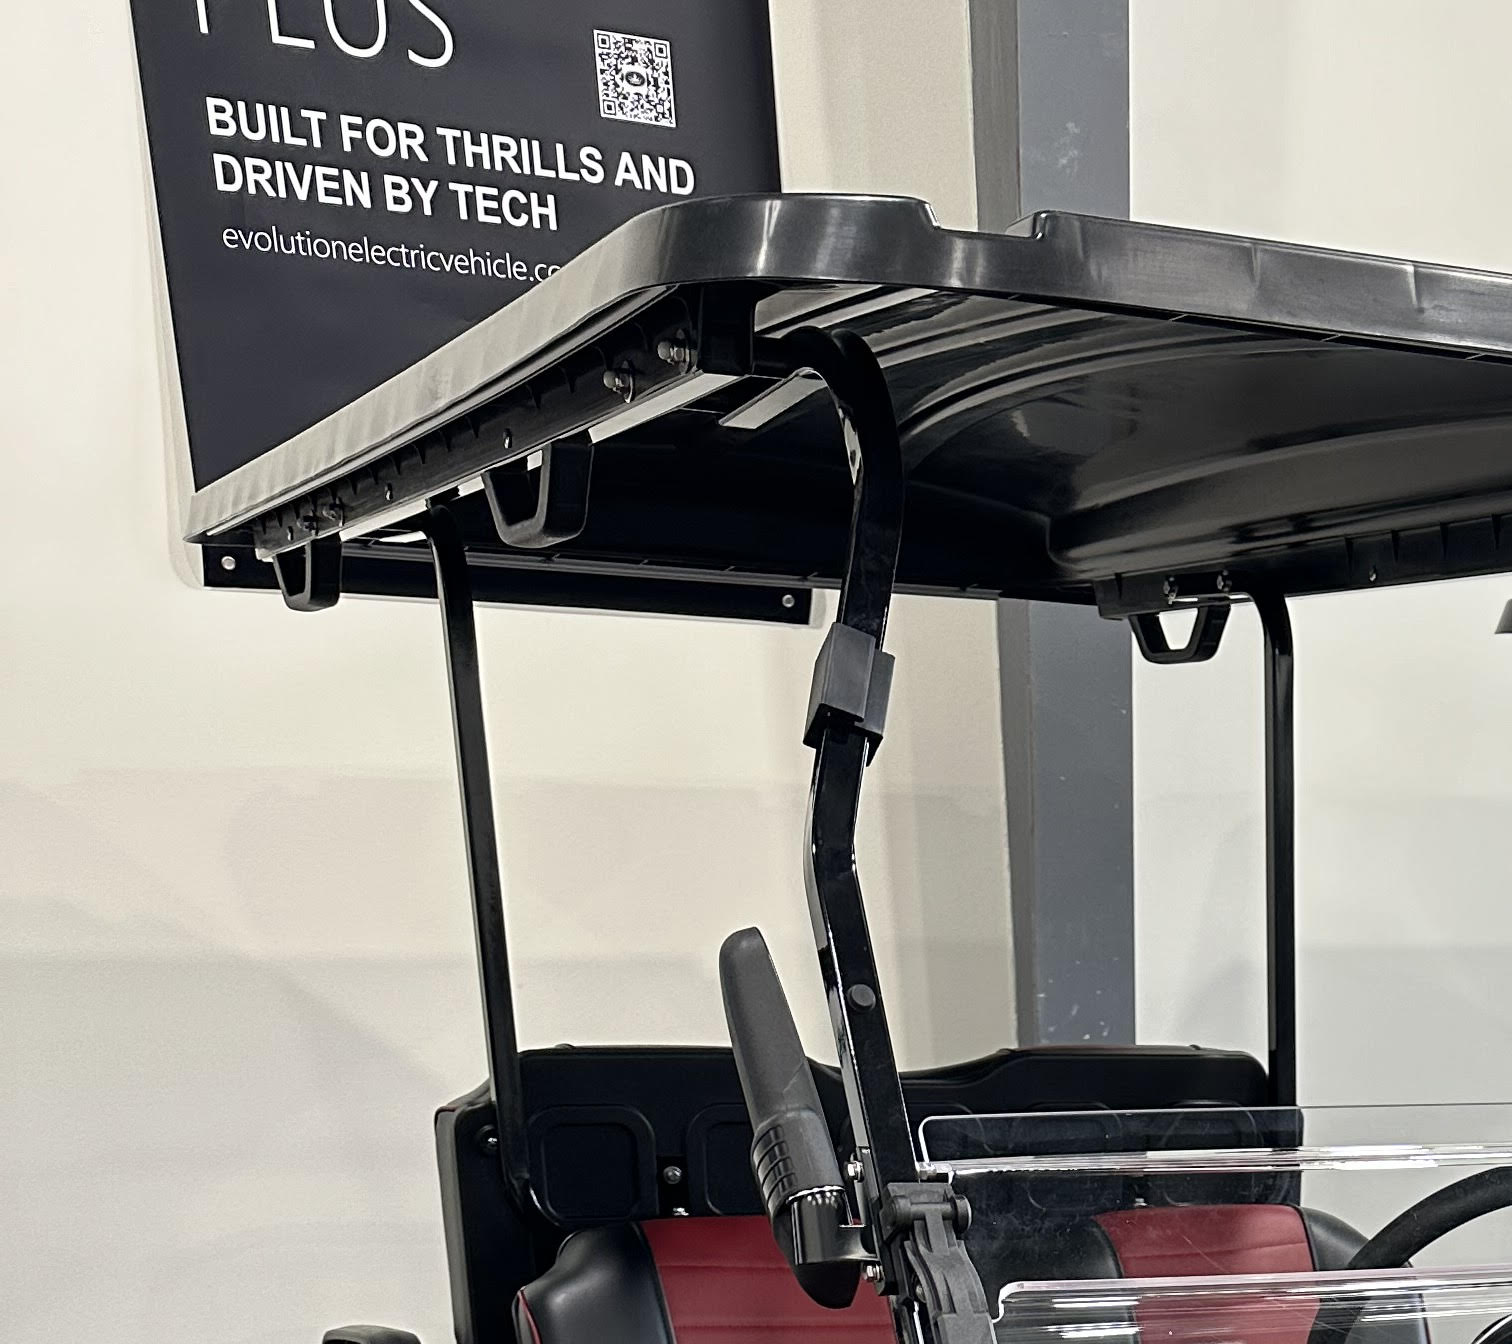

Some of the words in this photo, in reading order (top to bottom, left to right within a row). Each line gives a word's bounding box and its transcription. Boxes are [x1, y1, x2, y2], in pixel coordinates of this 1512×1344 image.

[205, 96, 327, 148] BUILT
[339, 113, 429, 162] FOR
[435, 126, 605, 184] THRILLS
[614, 151, 695, 196] AND
[212, 153, 372, 209] DRIVEN
[383, 174, 439, 216] BY
[448, 182, 558, 231] TECH
